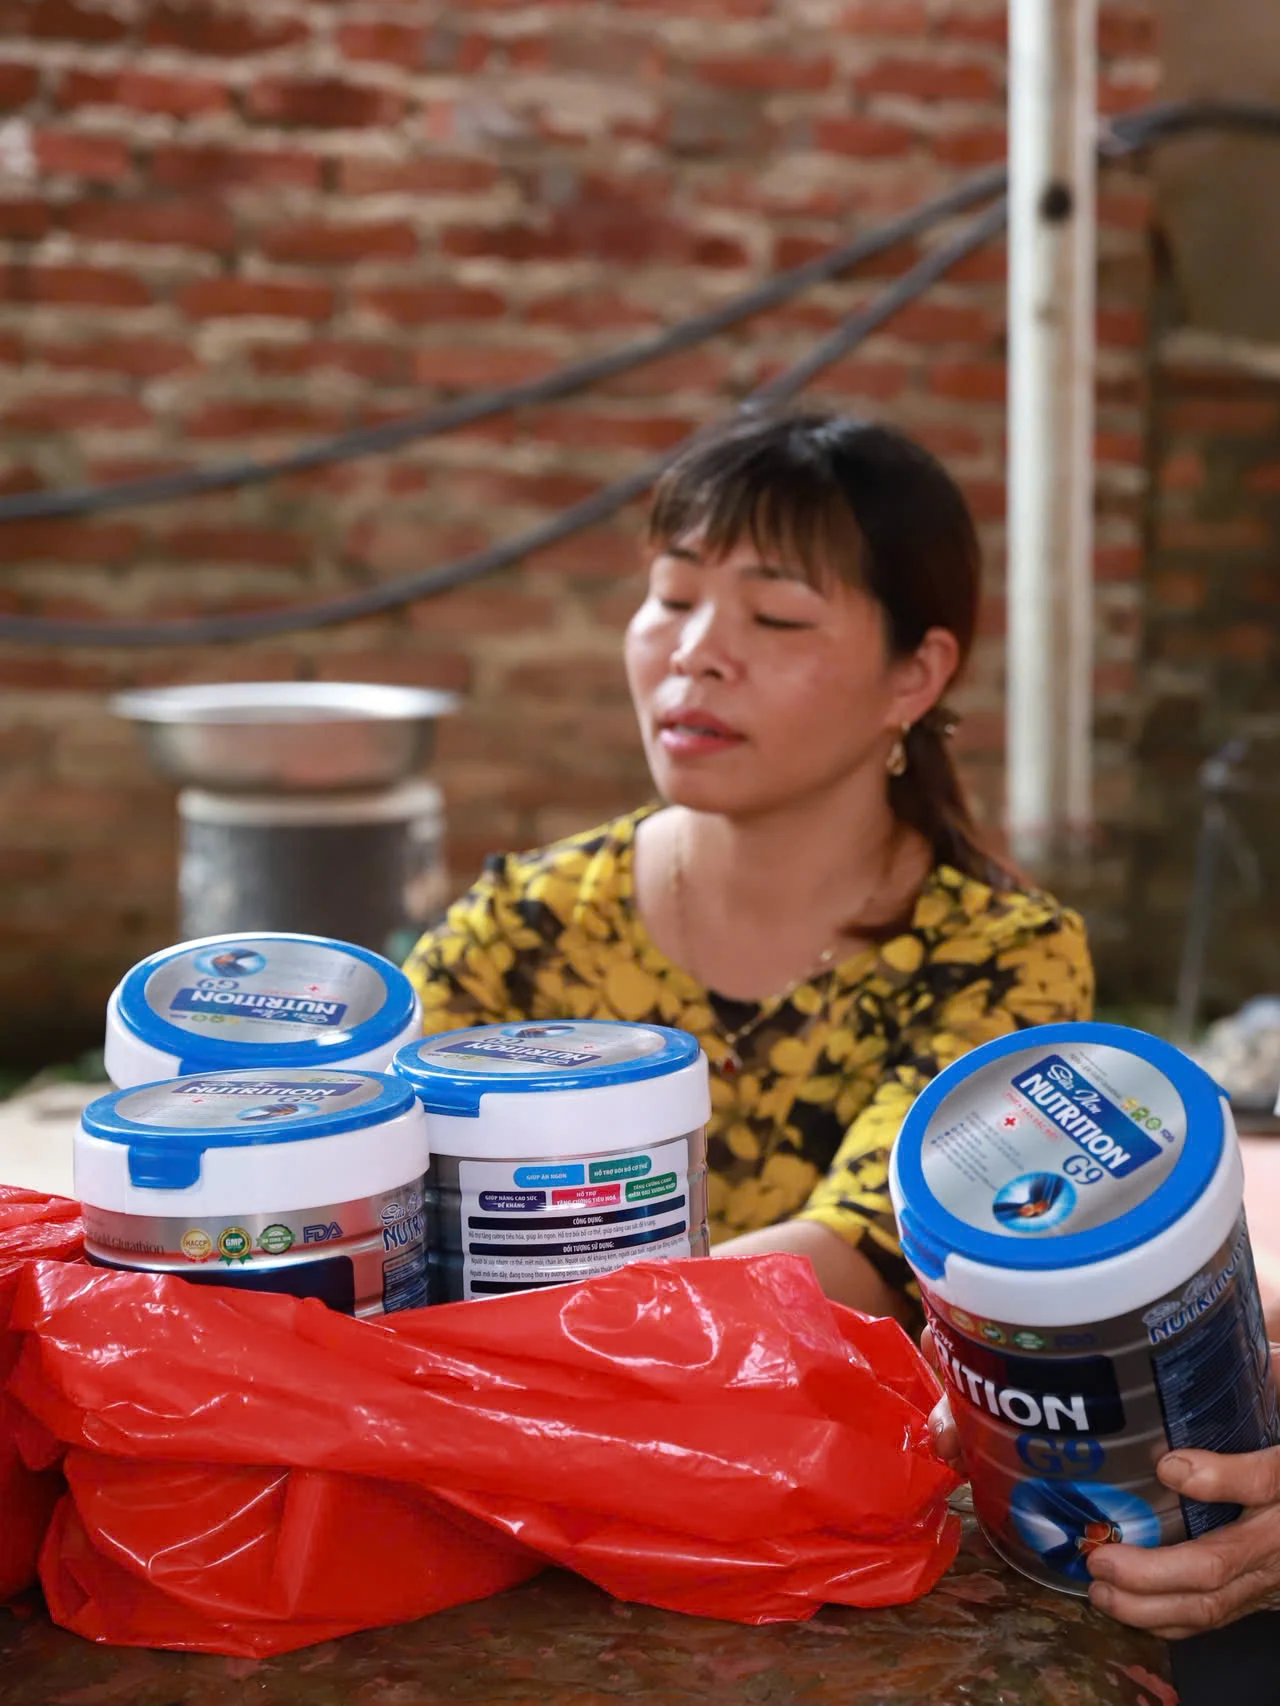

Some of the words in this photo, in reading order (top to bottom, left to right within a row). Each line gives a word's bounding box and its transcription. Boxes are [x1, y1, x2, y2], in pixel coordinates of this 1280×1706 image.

[191, 990, 338, 1015] NUTRITION
[464, 1042, 592, 1061] NUTRITION
[183, 1085, 337, 1096] NUTRITION
[1019, 1073, 1131, 1170] NUTRITION
[1062, 1154, 1105, 1186] G9
[572, 1217, 587, 1225] CÔNG
[303, 1221, 343, 1243] FDA
[185, 1239, 208, 1247] HACCP
[225, 1238, 243, 1247] GMP
[1016, 1432, 1105, 1476] G9
